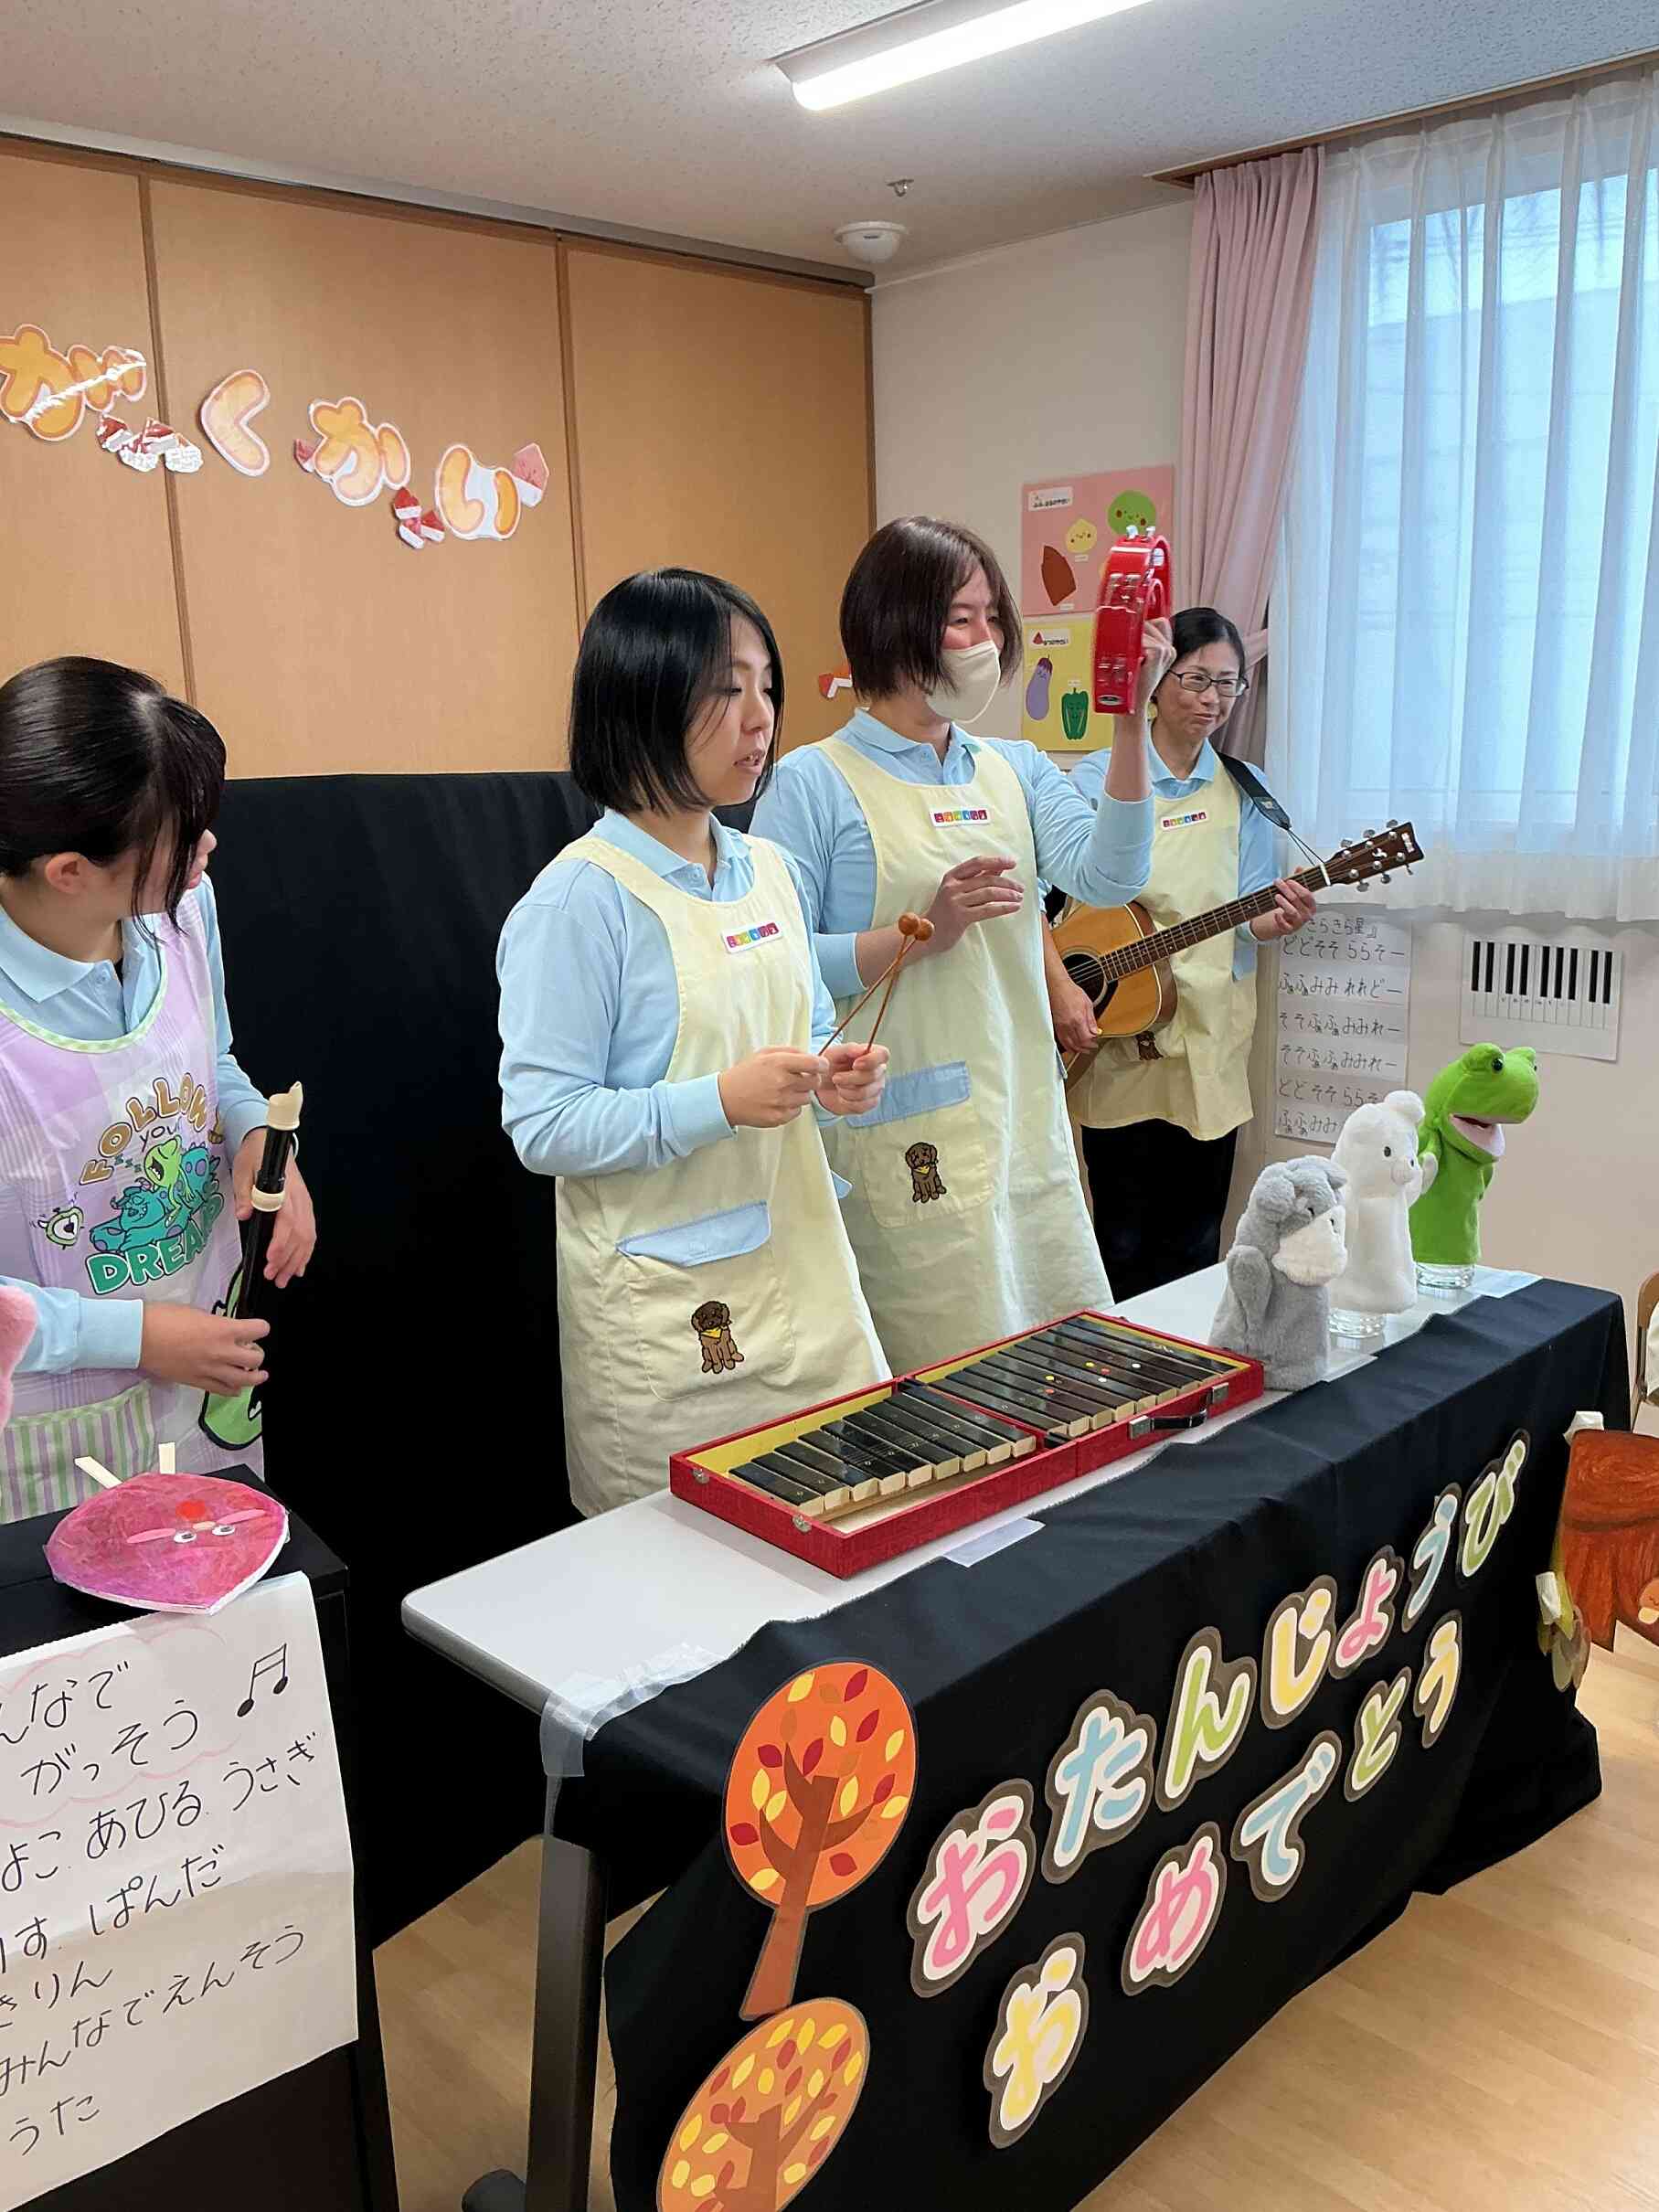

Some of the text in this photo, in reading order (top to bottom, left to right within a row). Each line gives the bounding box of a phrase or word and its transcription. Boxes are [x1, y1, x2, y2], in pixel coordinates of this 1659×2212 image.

[918, 1437, 1527, 1981] おたんじょうび
[223, 1731, 316, 1812] うさぎ
[90, 1845, 225, 1936] ぱんだ
[993, 1618, 1460, 2132] おめでとう
[10, 2094, 100, 2155] うた
